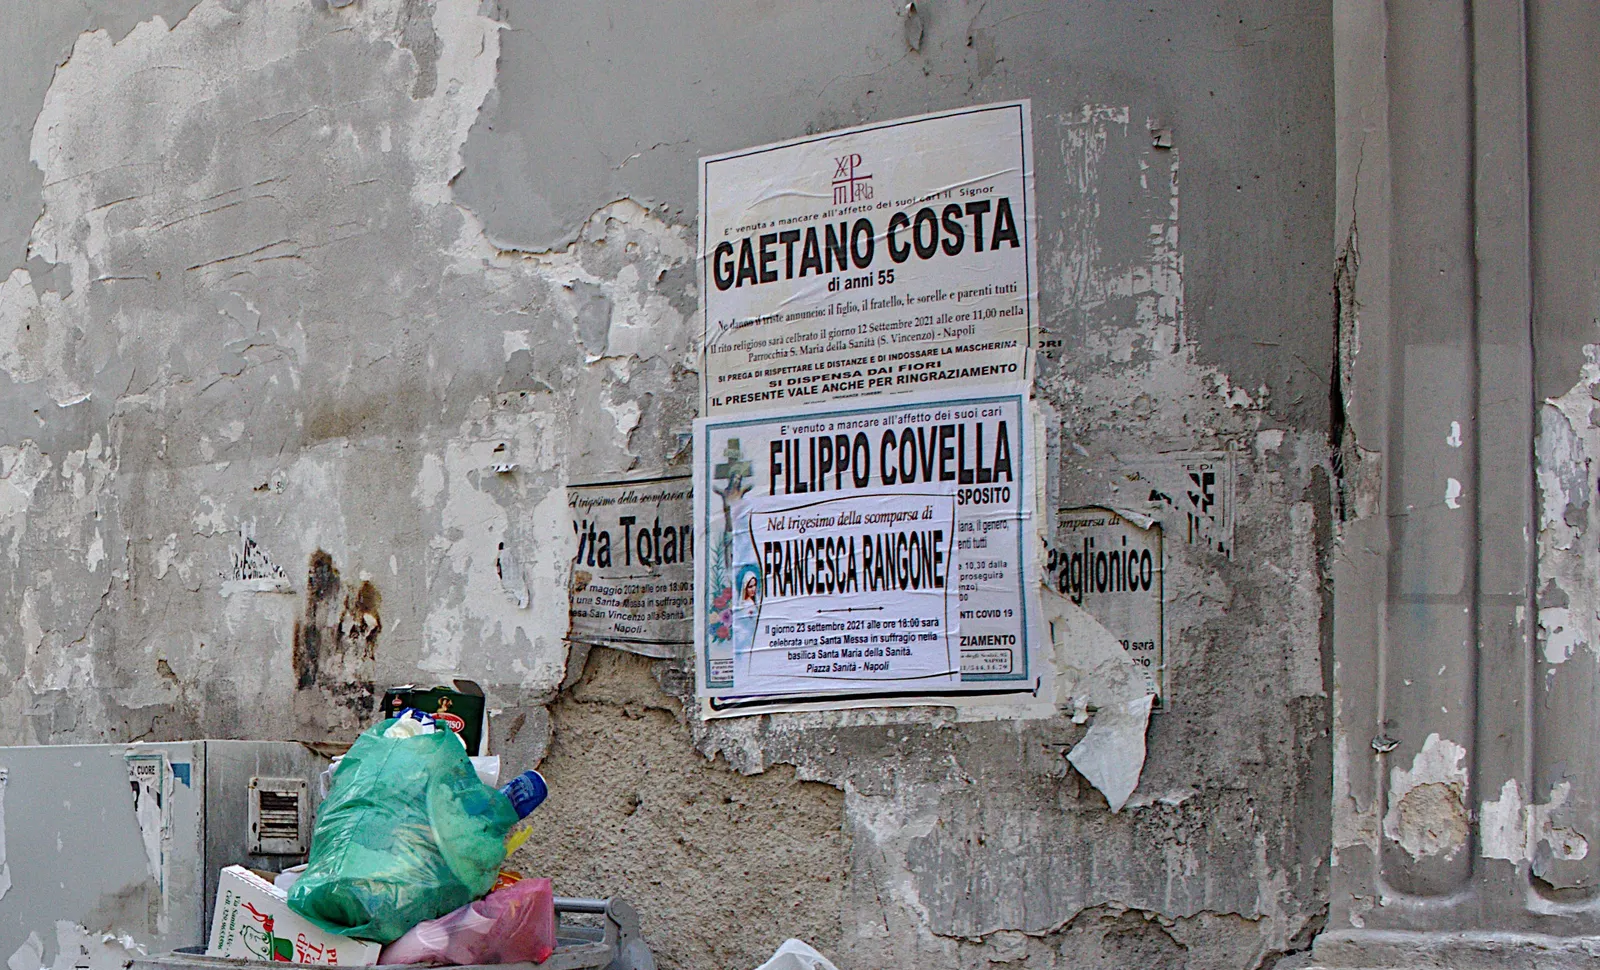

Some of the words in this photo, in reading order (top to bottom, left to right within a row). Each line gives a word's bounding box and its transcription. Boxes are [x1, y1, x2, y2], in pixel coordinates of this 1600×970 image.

[736, 223, 766, 233] venuta
[779, 213, 819, 225] mancare
[822, 205, 872, 218] all'affetto
[960, 186, 994, 197] Signor
[713, 218, 874, 291] GAETANO
[887, 197, 1020, 263] COSTA
[828, 277, 839, 292] di
[845, 272, 873, 289] anni
[878, 269, 894, 285] 55
[786, 309, 825, 322] annuncio:
[836, 303, 860, 315] figlio,
[871, 296, 904, 310] fratello,
[917, 290, 947, 303] sorelle
[958, 284, 992, 302] parenti
[995, 282, 1017, 294] tutti
[718, 342, 731, 352] rito
[734, 338, 766, 351] religioso
[768, 334, 784, 345] sarà
[829, 327, 855, 340] giorno
[858, 324, 867, 334] 12
[869, 319, 912, 333] Settembre
[915, 316, 933, 326] 2021
[936, 313, 952, 324] alle
[955, 313, 970, 322] ore
[973, 308, 996, 320] 11,00
[999, 305, 1023, 317] nella
[749, 350, 788, 363] Parrocchia
[800, 343, 823, 356] Maria
[826, 343, 847, 352] della
[849, 338, 874, 349] Sanità
[891, 329, 935, 343] Vincenzo)
[944, 325, 975, 340] Napoli
[728, 371, 752, 381] PREGA
[765, 364, 812, 376] RISPETTARE
[815, 362, 825, 370] LE
[827, 357, 867, 369] DISTANZE
[889, 349, 938, 360] INDOSSARE
[941, 347, 952, 355] LA
[955, 340, 1017, 353] MASCHERINA
[787, 370, 861, 385] DISPENSA
[868, 367, 892, 376] DAI
[899, 361, 941, 372] FIORI
[712, 398, 722, 406] IL
[726, 390, 784, 405] PRESENTE
[788, 386, 817, 397] VALE
[822, 380, 864, 393] ANCHE
[869, 376, 892, 388] PER
[897, 363, 1017, 384] RINGRAZIAMENTO
[793, 424, 825, 434] venuto
[837, 419, 879, 430] mancare
[883, 413, 930, 425] all'affetto
[935, 410, 950, 420] dei
[954, 408, 977, 419] suoi
[981, 406, 1002, 417] cari
[769, 431, 870, 496] FILIPPO
[880, 420, 1013, 485] COVELLA
[618, 491, 638, 504] della
[767, 516, 784, 531] Nel
[788, 514, 834, 533] trigesimo
[838, 511, 861, 526] della
[864, 511, 918, 527] scomparsa
[922, 505, 933, 520] di
[1108, 515, 1120, 526] di
[983, 520, 1009, 533] genero,
[973, 537, 987, 549] tutti
[764, 536, 858, 597] FRANCESCA
[862, 530, 944, 592] RANGONE
[965, 561, 985, 570] 10,30
[960, 572, 1003, 581] proseguirà
[590, 585, 623, 596] maggio
[624, 585, 639, 594] 2021
[595, 596, 619, 607] Santa
[590, 609, 605, 618] San
[609, 610, 645, 621] Vincenzo
[976, 610, 1000, 618] COVID
[1004, 609, 1012, 617] 19
[614, 623, 642, 634] Napoli
[772, 625, 794, 636] giorno
[797, 623, 805, 632] 23
[807, 622, 844, 632] settembre
[847, 621, 864, 630] 2021
[867, 620, 880, 629] alle
[898, 618, 918, 628] 18:00
[922, 618, 939, 627] sarà
[769, 638, 802, 647] celebrata
[820, 636, 841, 645] Santa
[843, 635, 868, 643] Messa
[871, 634, 877, 642] in
[880, 632, 916, 644] suffragio
[960, 635, 1016, 646] ZIAMENTO
[788, 650, 815, 660] basilica
[818, 650, 839, 659] Santa
[841, 649, 862, 658] Maria
[864, 648, 883, 657] della
[886, 647, 913, 657] Sanità.
[807, 664, 830, 673] Piazza
[832, 661, 856, 672] Sanità
[863, 661, 889, 672] Napoli
[137, 766, 155, 775] CUORE
